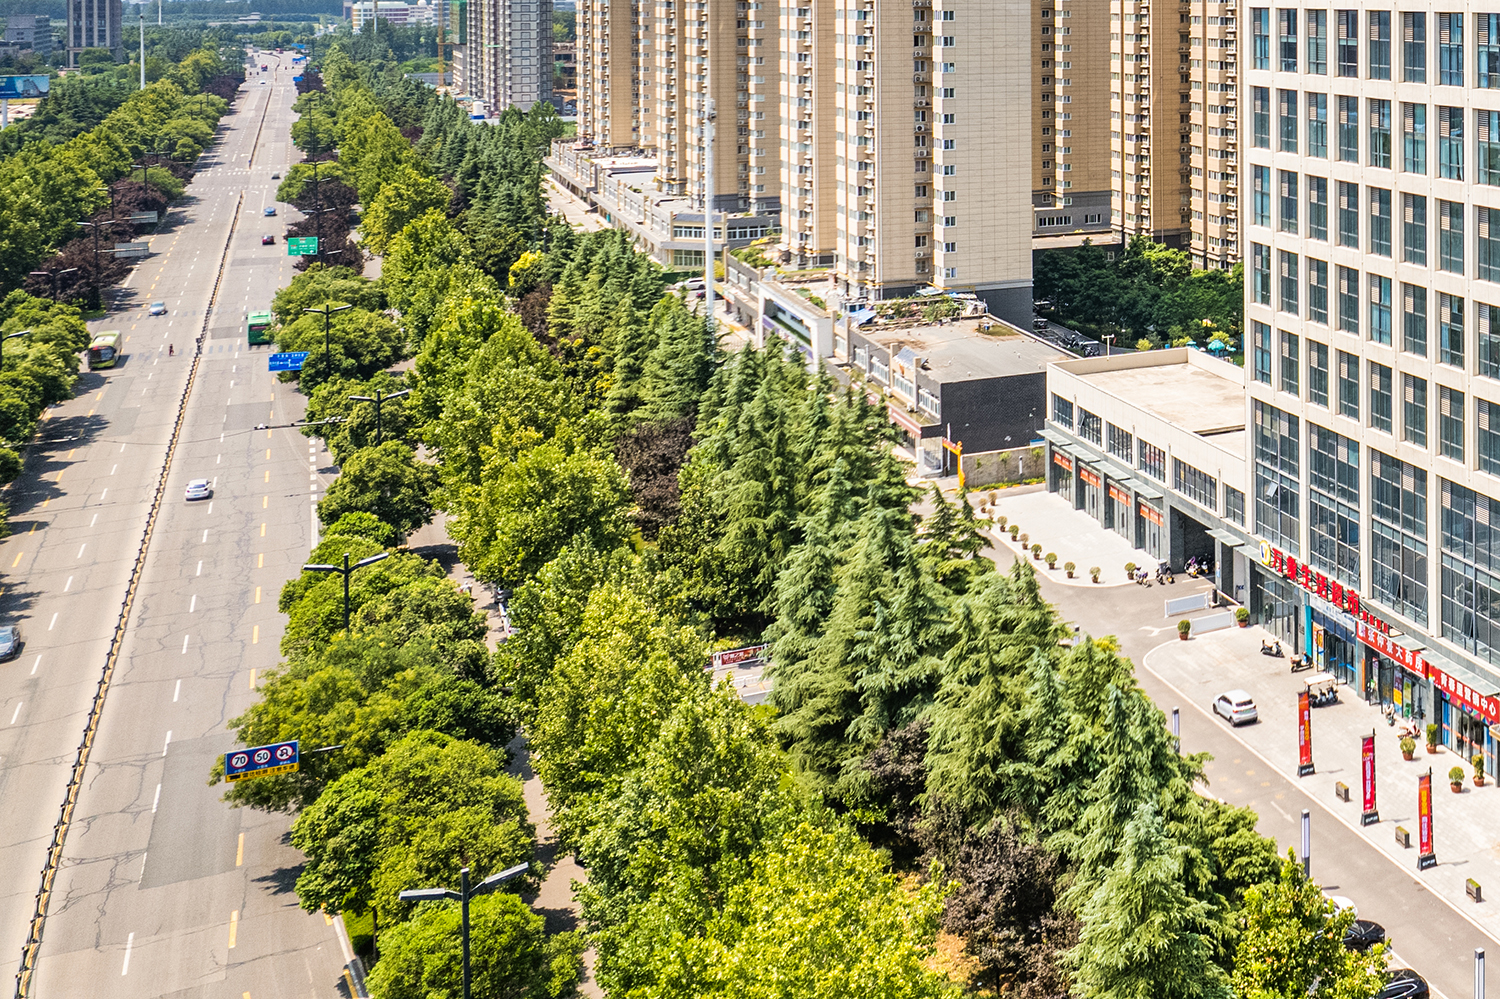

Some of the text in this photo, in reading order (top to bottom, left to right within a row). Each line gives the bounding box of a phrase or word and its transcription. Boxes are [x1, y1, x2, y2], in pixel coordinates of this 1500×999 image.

[1272, 547, 1359, 616] 万象生活超市
[234, 756, 246, 766] 70
[256, 752, 269, 762] 50
